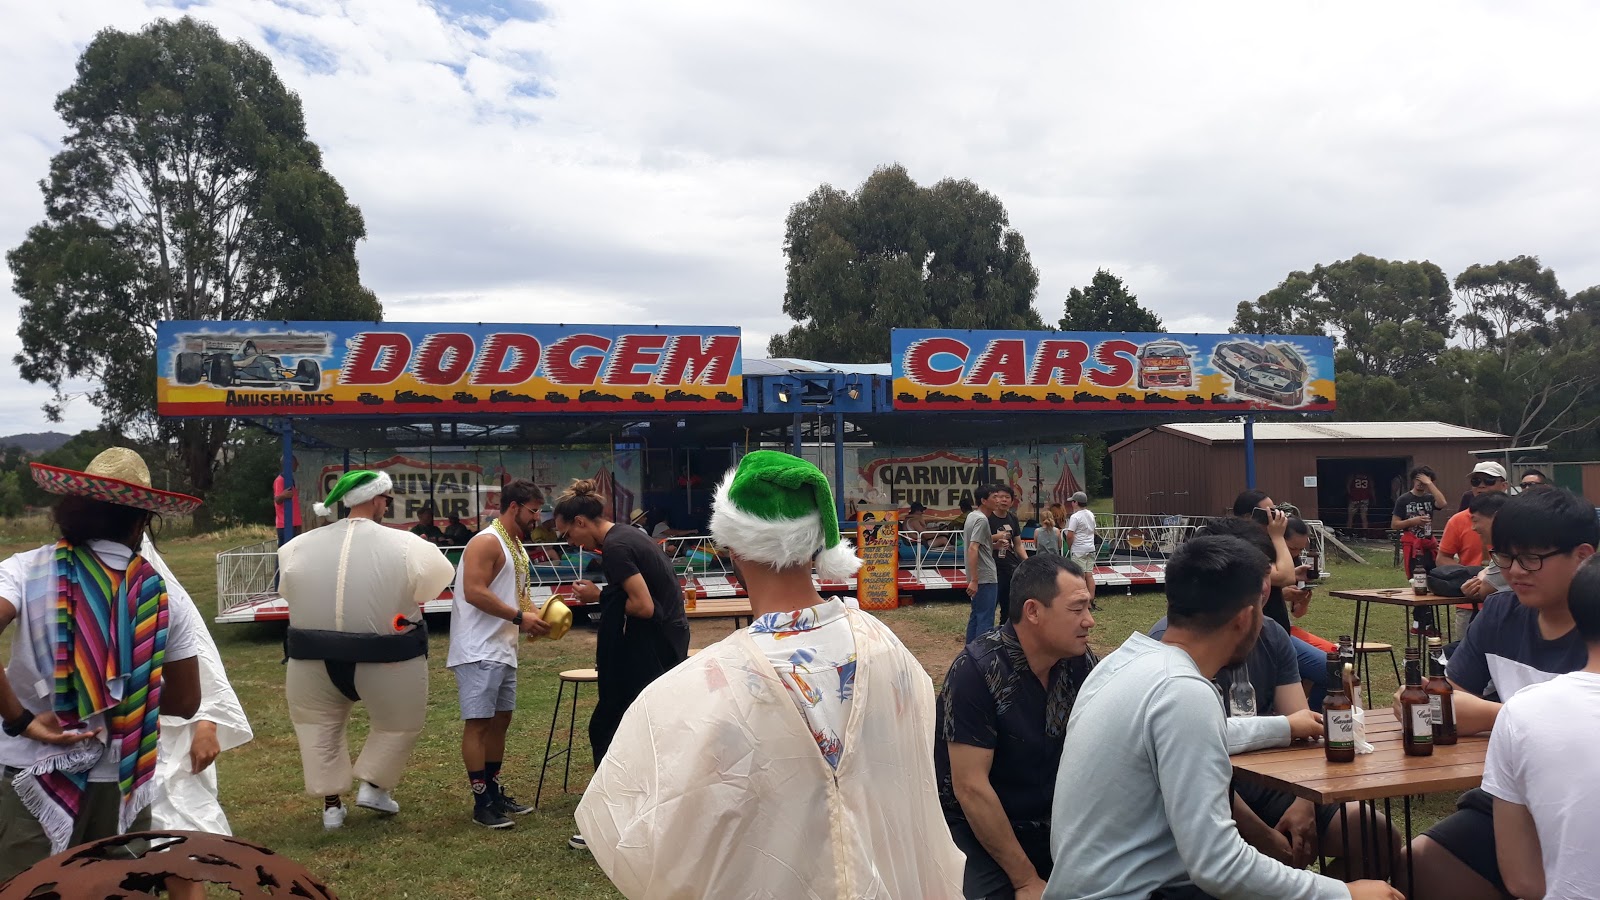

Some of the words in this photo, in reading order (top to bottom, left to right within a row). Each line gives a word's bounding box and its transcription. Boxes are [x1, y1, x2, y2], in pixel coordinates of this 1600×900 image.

[337, 332, 740, 386] DODGEM
[904, 337, 1140, 387] CARS
[225, 390, 335, 406] AMUSEMENTS
[879, 465, 1005, 485] CARNIVAL
[1354, 479, 1369, 489] 23
[893, 488, 940, 506] FUN
[947, 489, 977, 506] FA
[405, 498, 470, 519] FAIR
